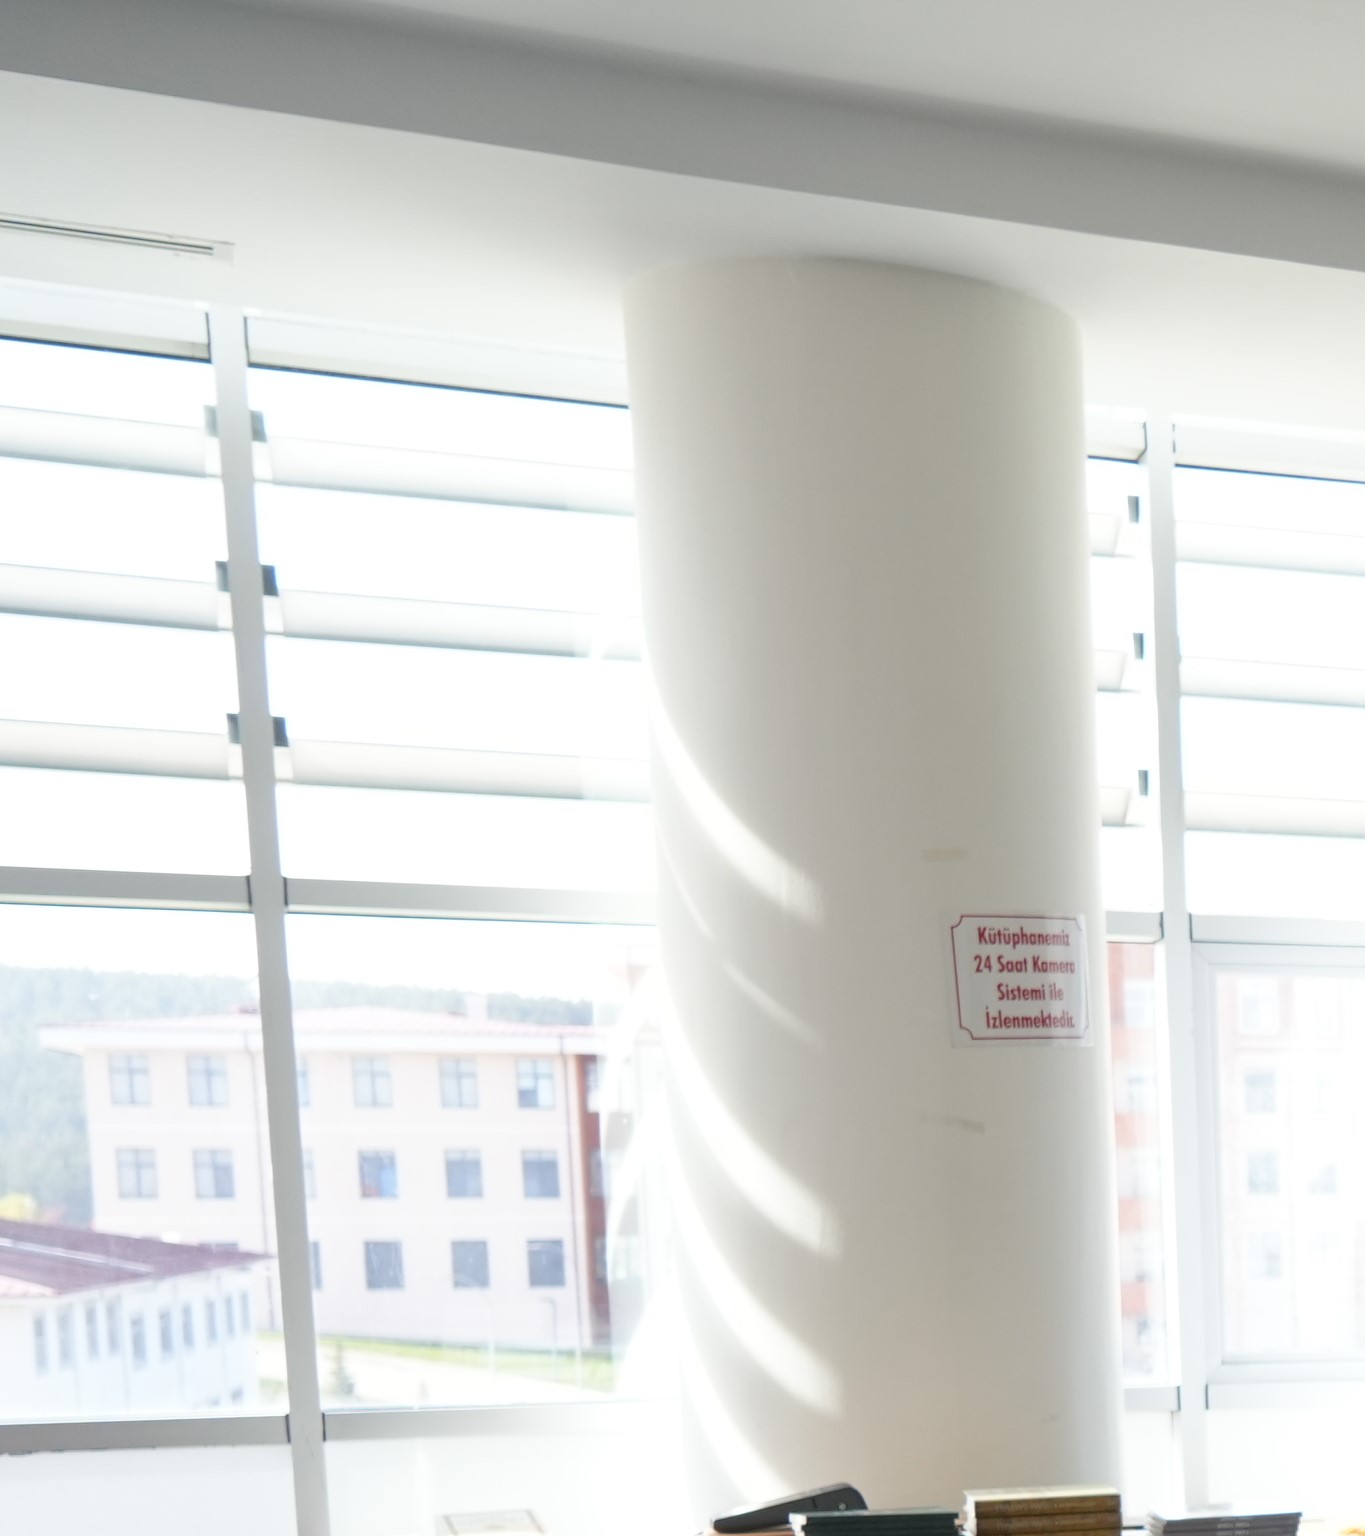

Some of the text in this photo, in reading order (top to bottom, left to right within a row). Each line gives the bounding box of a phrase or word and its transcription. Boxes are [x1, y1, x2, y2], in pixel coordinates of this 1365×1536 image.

[977, 926, 1071, 949] Kütüphanemiz
[974, 955, 1076, 974] 24 Saat Kamera
[997, 983, 1064, 1001] Sistemi ile
